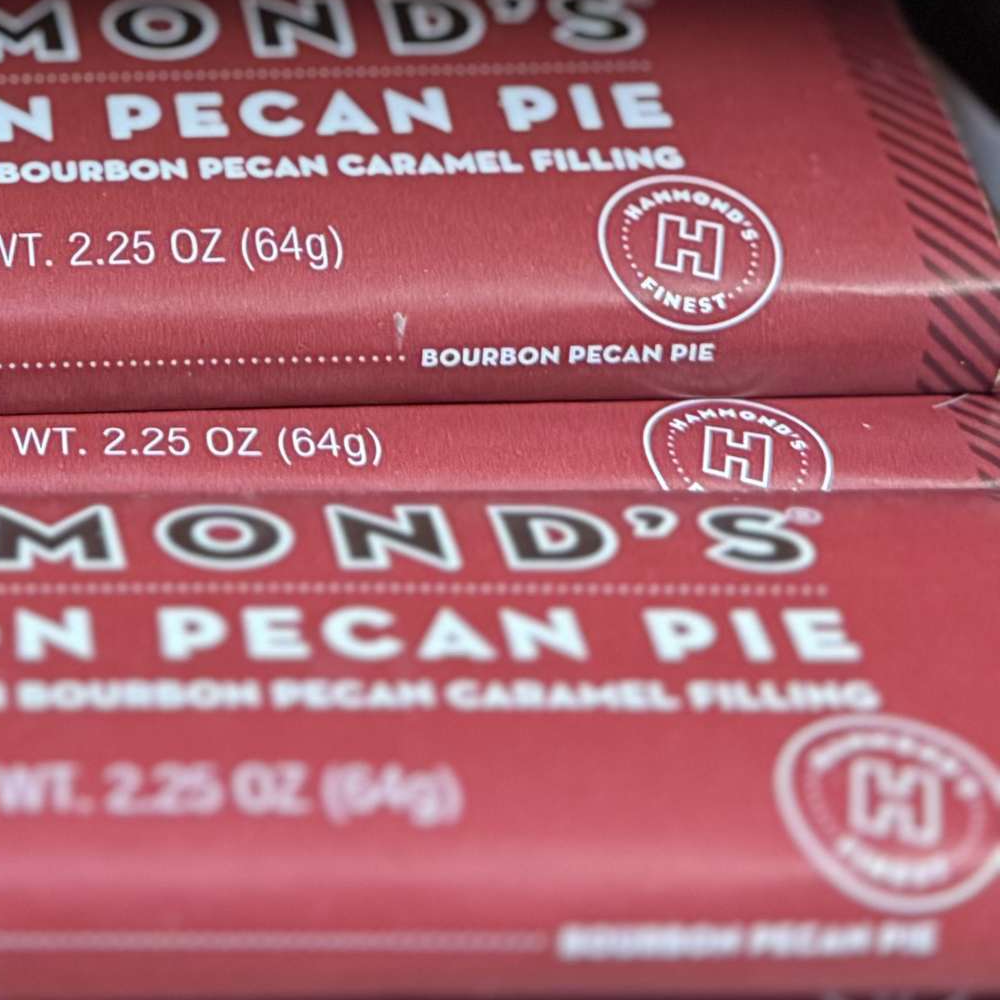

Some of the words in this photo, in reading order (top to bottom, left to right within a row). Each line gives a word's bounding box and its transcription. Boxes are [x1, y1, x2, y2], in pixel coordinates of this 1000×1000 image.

[106, 88, 452, 140] PECAN
[499, 82, 673, 131] PIE
[199, 155, 328, 179] PECAN
[338, 150, 524, 176] CARAMEL
[531, 146, 686, 171] FILLING
[623, 189, 760, 242] HAMMOND'S
[69, 231, 155, 266] 2.25
[171, 228, 225, 263] OZ
[242, 226, 343, 271] (64g)
[640, 276, 727, 313] FINEST
[422, 346, 560, 367] BOURBON
[569, 344, 662, 364] PECAN
[671, 343, 715, 362] PIE
[12, 428, 86, 455] WT.
[103, 428, 190, 456] 2.25
[206, 427, 262, 456] OZ
[278, 427, 382, 466] (64g)
[668, 408, 808, 451] HAMMOND'S
[157, 606, 588, 661] PECAN
[643, 608, 861, 662] PIE
[16, 679, 260, 710] BOURBON
[270, 679, 436, 709] PECAN
[445, 680, 680, 711] CARAMEL
[687, 680, 881, 711] FILLING
[106, 763, 224, 815] 2.25
[232, 762, 308, 814] OZ
[322, 764, 463, 827] (64g)
